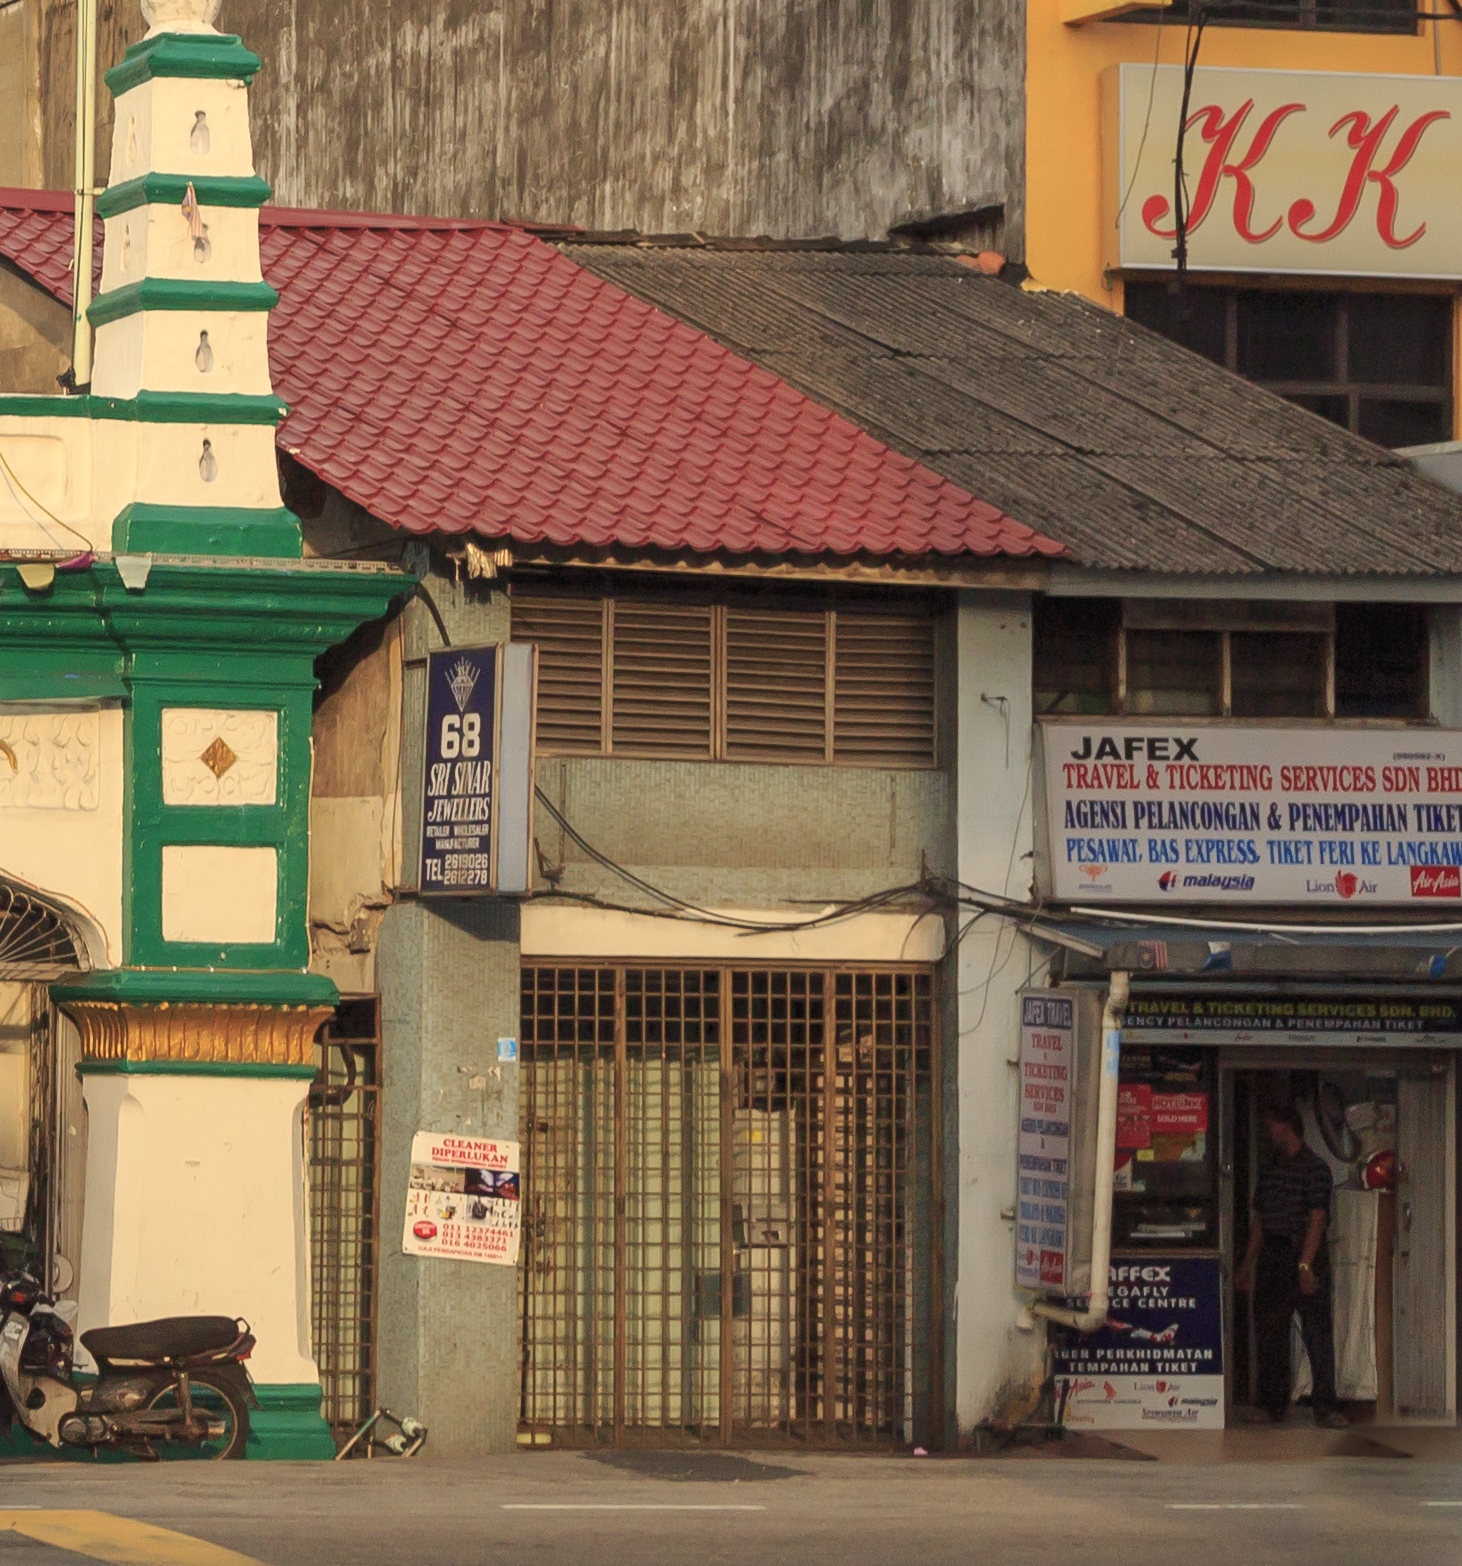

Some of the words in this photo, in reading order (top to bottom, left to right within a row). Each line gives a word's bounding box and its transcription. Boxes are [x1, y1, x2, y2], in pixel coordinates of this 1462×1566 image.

[440, 712, 481, 759] 68
[1071, 736, 1199, 761] JAFEX
[428, 763, 451, 797] SRI
[451, 760, 491, 795] SINAR
[1063, 763, 1141, 790] TRAVEL
[1146, 764, 1160, 790] &
[1165, 764, 1273, 791] TICKETING
[1280, 765, 1376, 792] SERVICES
[1382, 766, 1420, 792] SDN
[428, 797, 490, 822] JEWELLERS
[1064, 800, 1127, 829] AGENSI
[1132, 800, 1260, 831] PELANCONGAN
[1267, 801, 1282, 830] &
[1287, 803, 1407, 832] PENEMPAHAN
[1147, 838, 1179, 863] BAS
[1266, 840, 1313, 864] TIKET
[1319, 840, 1355, 865] FERI
[1360, 840, 1381, 865] KE
[445, 854, 488, 869] 2619026
[444, 869, 487, 884] 2612278
[1182, 873, 1255, 891] malaysia
[1306, 879, 1334, 893] Lion
[1359, 880, 1377, 894] Air
[1129, 1002, 1188, 1014] TRAVEL
[1297, 1003, 1376, 1017] SERVICES
[1385, 1019, 1424, 1030] TIKET
[1032, 1033, 1062, 1051] TRAVEL
[443, 1139, 497, 1152] CLEANER
[432, 1147, 508, 1163] DIPERLUKAN
[443, 1223, 461, 1231] 011
[442, 1238, 460, 1247] 016
[1108, 1266, 1171, 1282] AFFEX
[1138, 1298, 1196, 1309] CENTRE
[1096, 1348, 1213, 1360] PERKHIDMATAN
[1069, 1362, 1149, 1373] TEMPAHAN
[1156, 1362, 1198, 1373] TIKET
